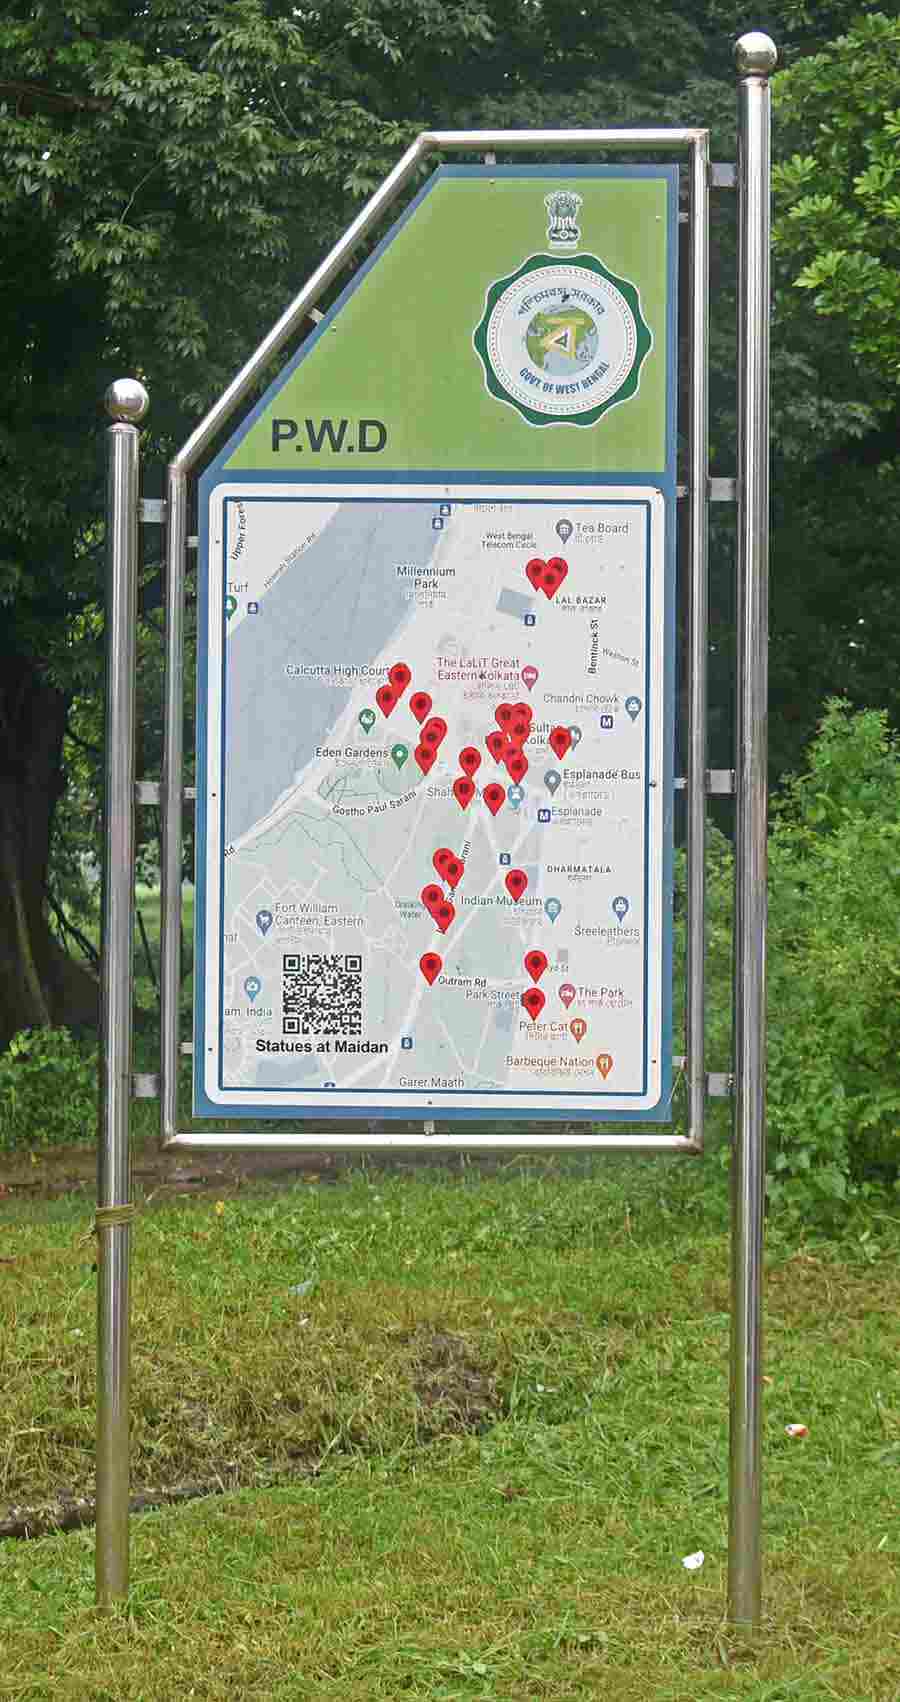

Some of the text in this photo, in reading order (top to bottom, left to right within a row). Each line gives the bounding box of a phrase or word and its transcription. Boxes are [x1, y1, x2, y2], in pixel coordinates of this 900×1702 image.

[543, 382, 554, 393] OF
[554, 382, 581, 394] WEST
[580, 361, 610, 389] BENGAL
[271, 418, 388, 453] P.W.D
[575, 522, 629, 534] Tea Board
[396, 566, 456, 577] Millennium
[227, 581, 249, 593] Turf
[414, 578, 440, 589] Park
[575, 596, 607, 605] BAZAR
[588, 631, 599, 674] Bentinck
[437, 657, 457, 668] The
[491, 657, 520, 668] Great
[286, 665, 331, 676] Calcutta
[334, 665, 358, 679] High
[438, 670, 520, 681] Eastern Kolkata
[543, 693, 621, 704] Chandni Chowk
[315, 748, 388, 758] Eden Gardens
[563, 768, 641, 782] Esplanade Bus
[332, 791, 417, 817] Gostho Paul Sarani
[551, 807, 602, 819] Esplanade
[547, 865, 612, 874] DHARMATALA
[461, 895, 496, 906] Indian
[275, 902, 338, 913] Fort William
[324, 916, 364, 927] Eastern
[574, 926, 640, 938] Sreeleathers
[438, 976, 487, 988] Outram Rd
[466, 989, 488, 1000] Park
[579, 986, 624, 998] The Park
[246, 1007, 272, 1018] India
[519, 1021, 569, 1032] Peter Cat
[255, 1039, 389, 1053] Statues at Maidan
[506, 1056, 595, 1070] Barbeque Nation
[431, 1077, 465, 1088] Maath
